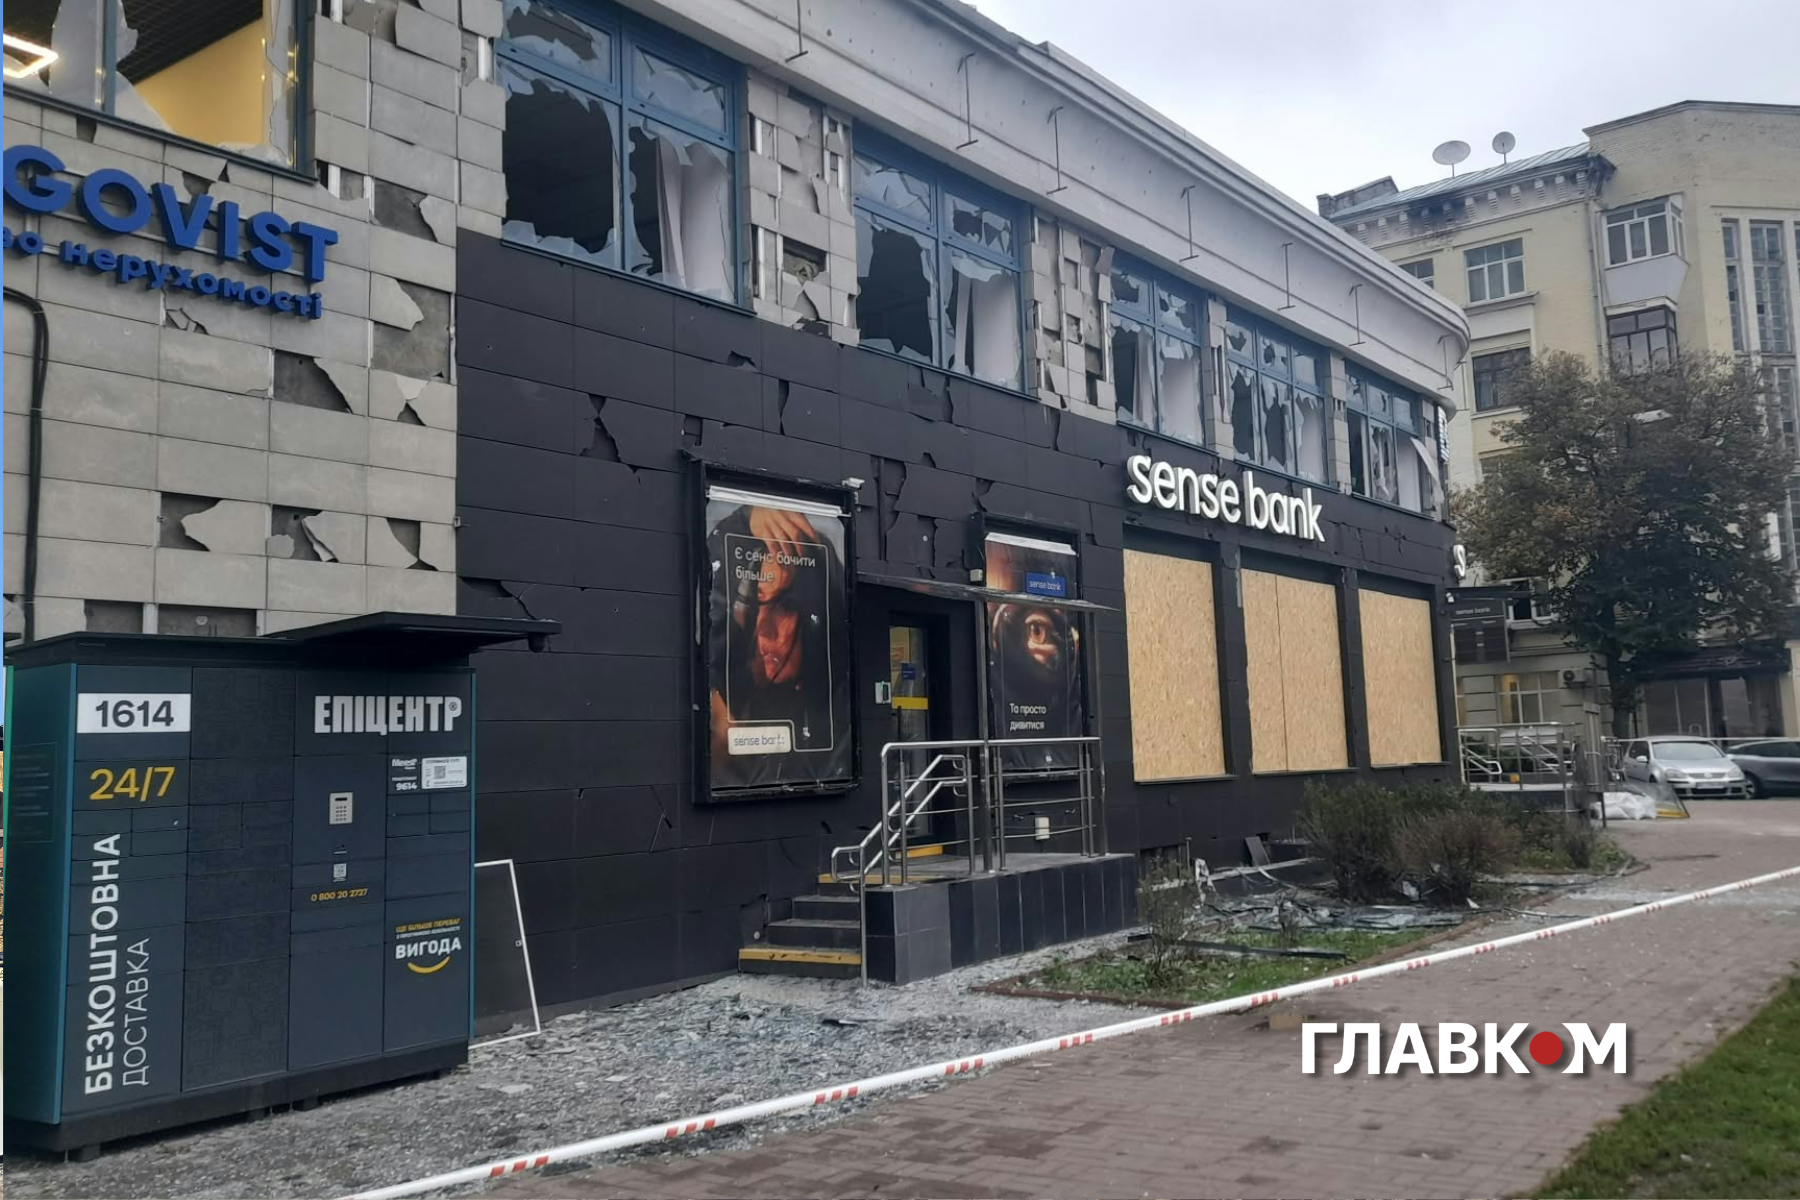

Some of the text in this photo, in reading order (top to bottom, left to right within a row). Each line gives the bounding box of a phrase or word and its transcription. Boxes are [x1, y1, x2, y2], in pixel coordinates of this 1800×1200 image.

[59, 240, 322, 320] нерухомості
[1126, 455, 1325, 542] sense bank
[734, 546, 816, 567] Є сенс бачити
[735, 565, 774, 582] більше
[95, 700, 174, 728] 1614
[314, 695, 462, 736] ЕПІЦЕНТР
[1020, 705, 1047, 717] просто
[1010, 720, 1045, 732] дивитися
[733, 736, 760, 746] sense
[89, 766, 176, 802] 24/7
[311, 893, 318, 902] 0
[319, 892, 336, 901] 800
[337, 890, 348, 899] 20
[395, 936, 462, 959] ВИГОДА
[84, 833, 121, 1095] БЕЗКОШТОВНА
[122, 937, 150, 1087] ДОСТАВКА
